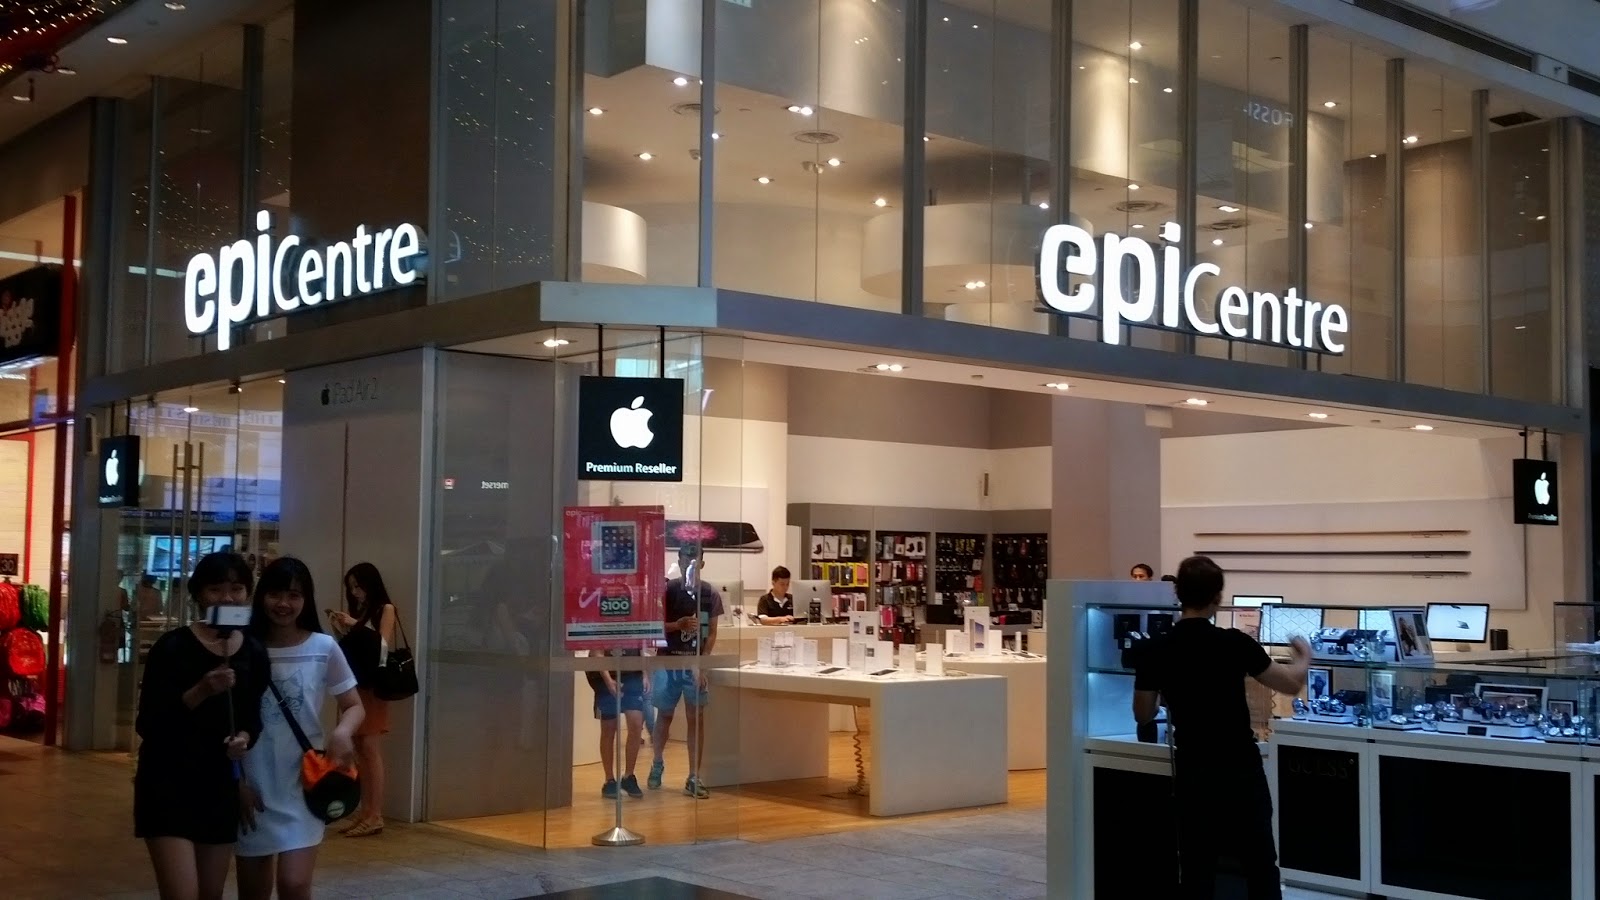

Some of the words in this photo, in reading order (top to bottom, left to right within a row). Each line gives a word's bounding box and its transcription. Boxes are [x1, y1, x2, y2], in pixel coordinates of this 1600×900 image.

[586, 462, 633, 473] Premium
[635, 463, 677, 474] Reseller
[601, 601, 630, 611] $100
